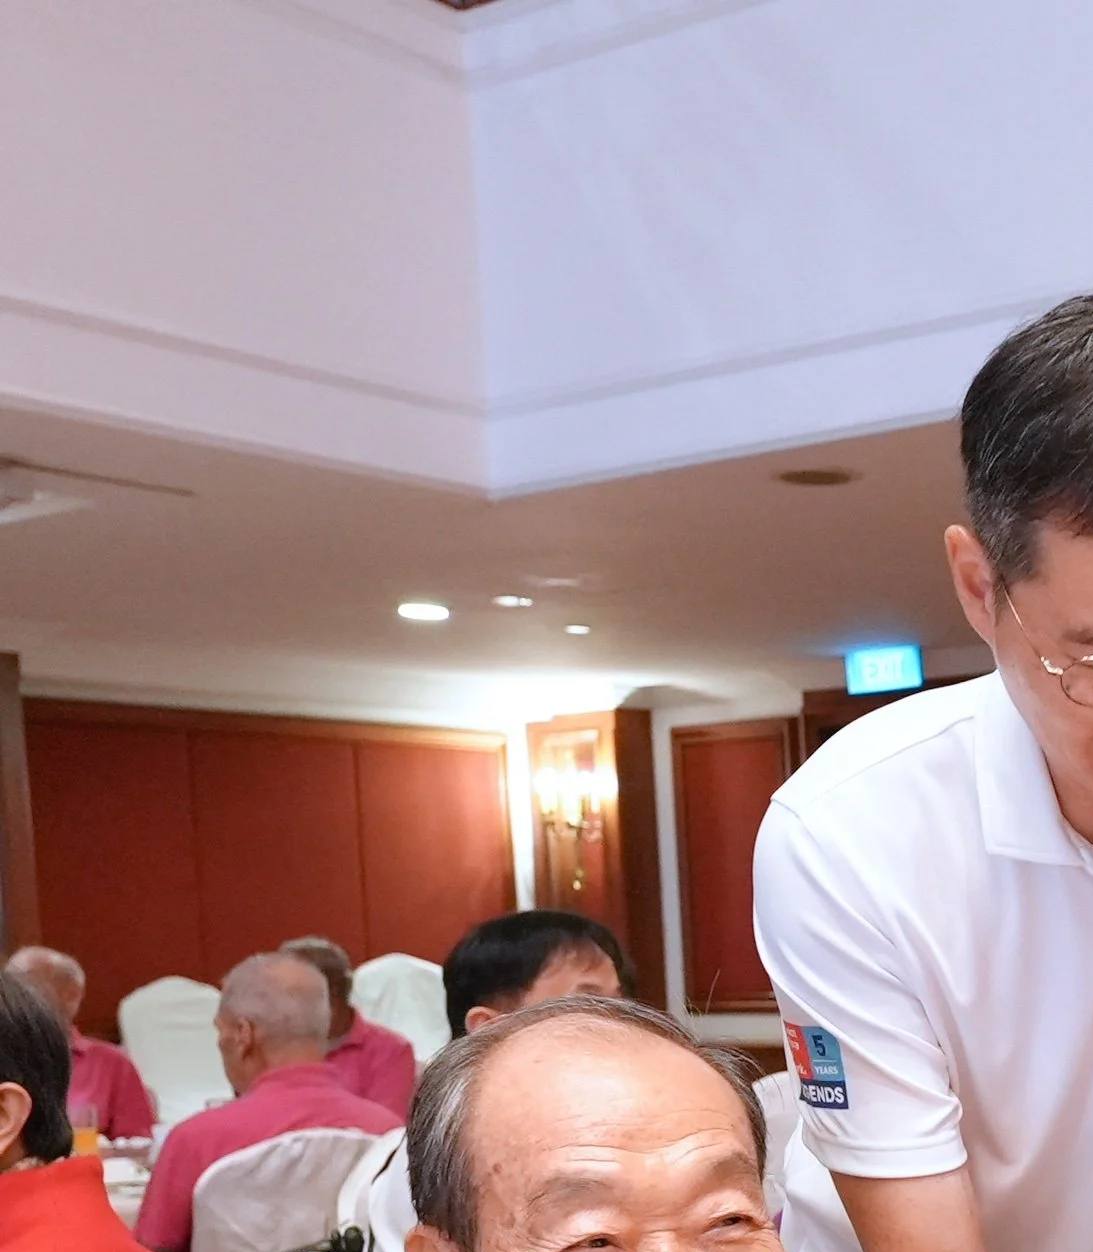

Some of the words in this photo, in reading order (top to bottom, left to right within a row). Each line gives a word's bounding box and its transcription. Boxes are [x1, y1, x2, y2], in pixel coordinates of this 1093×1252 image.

[862, 653, 905, 683] EXIT
[811, 1034, 827, 1057] 5
[813, 1065, 839, 1076] YEARS
